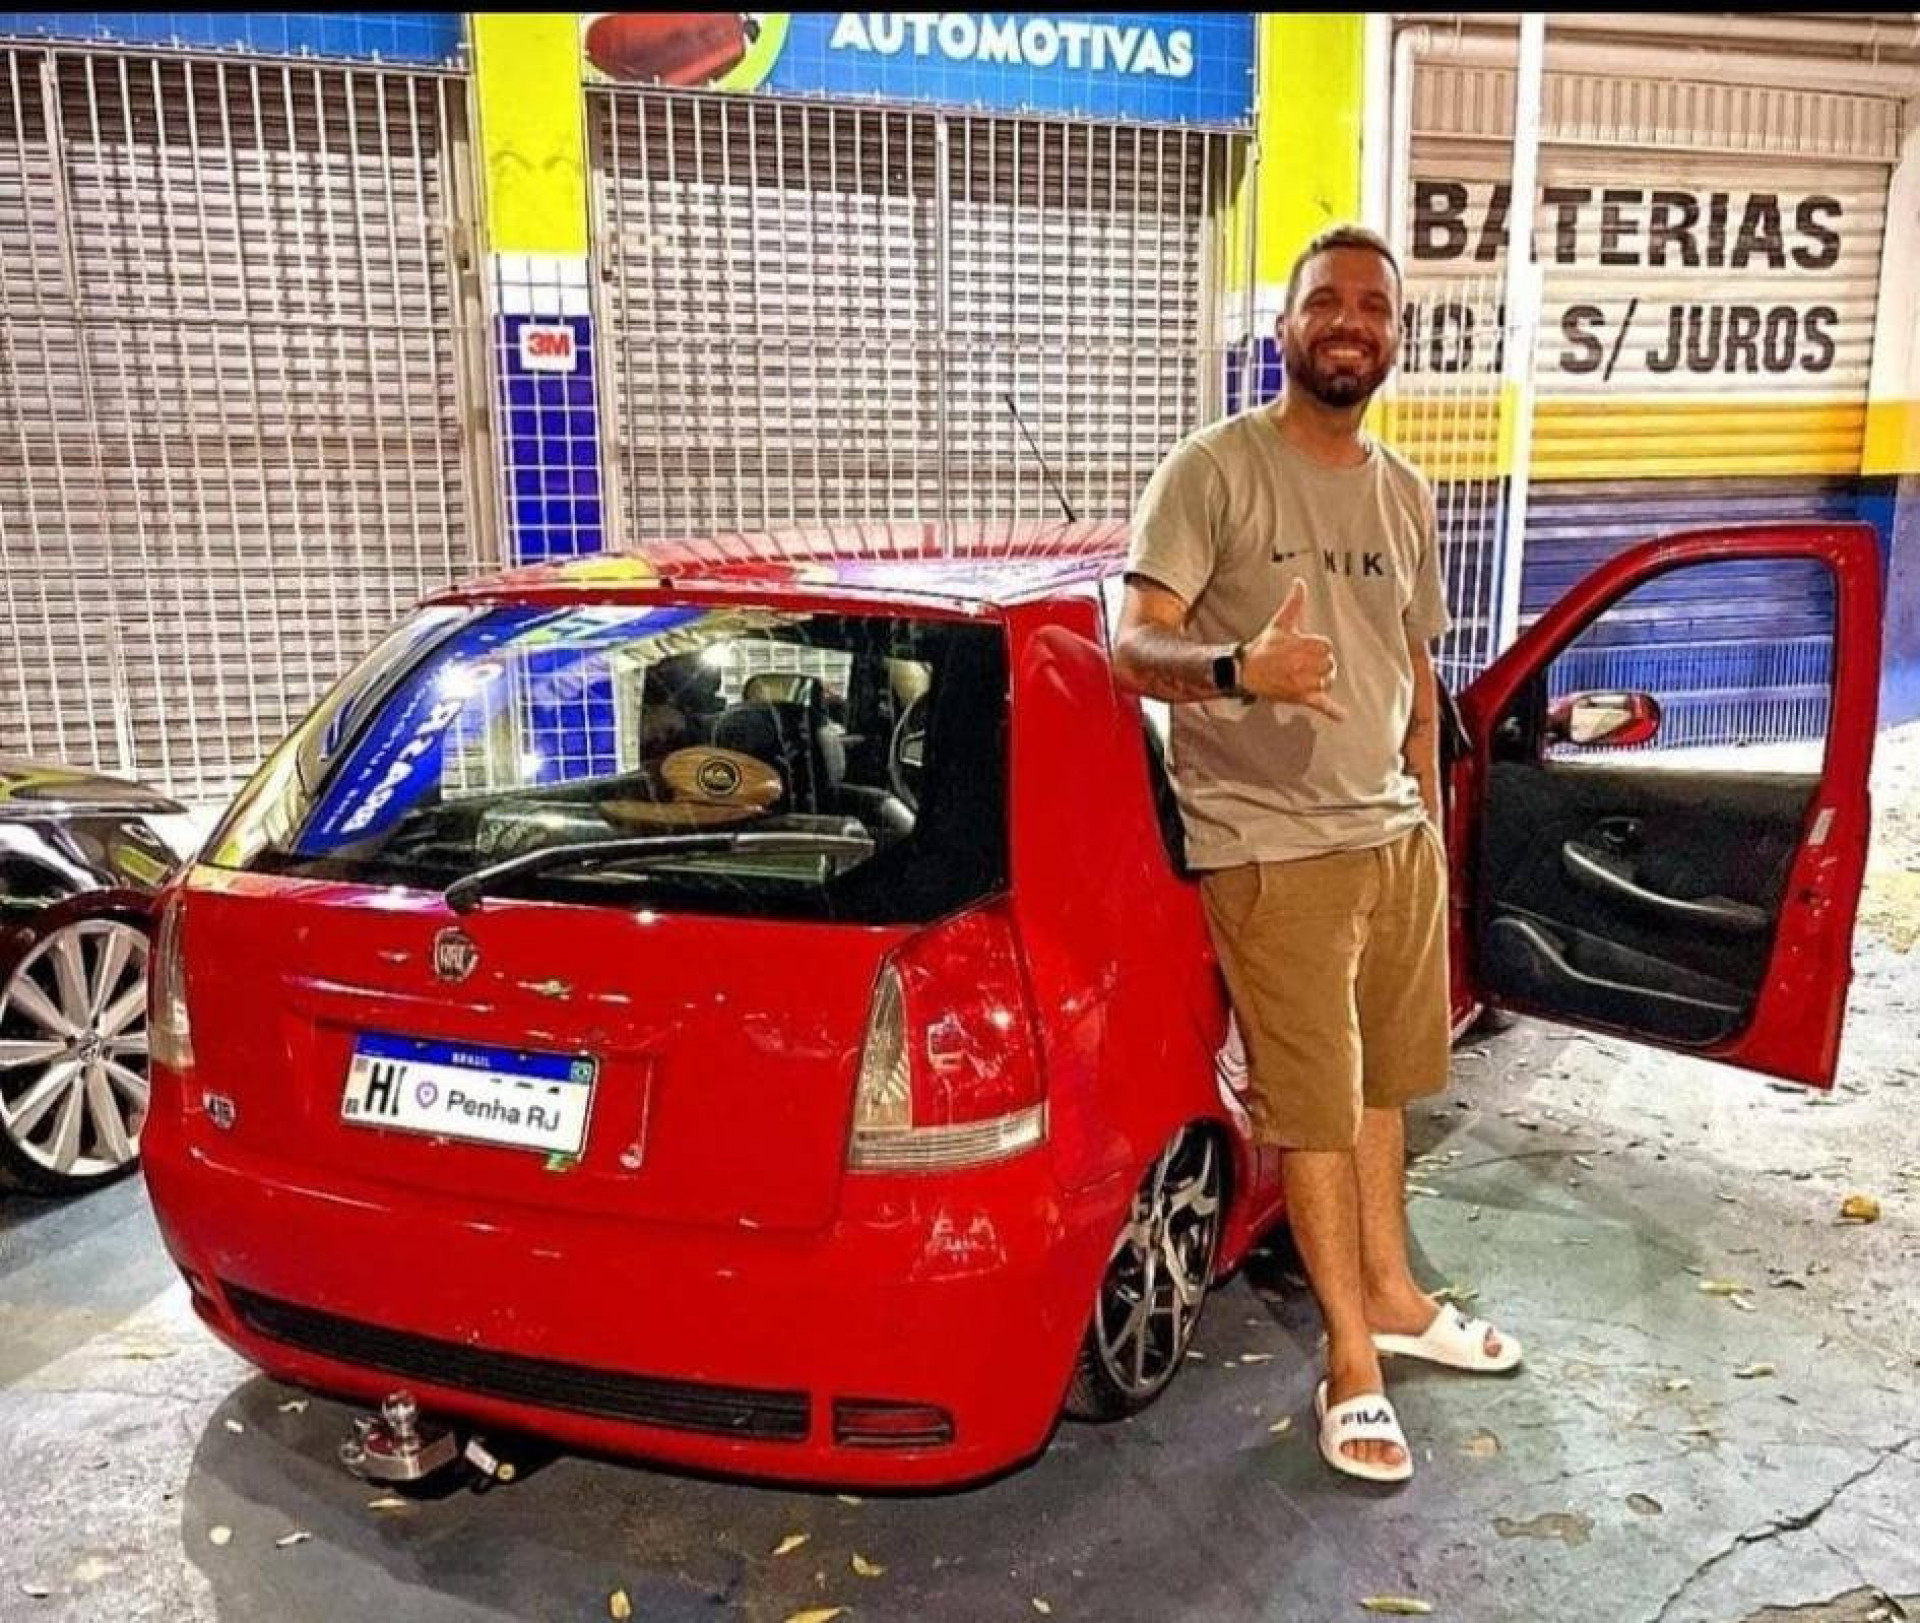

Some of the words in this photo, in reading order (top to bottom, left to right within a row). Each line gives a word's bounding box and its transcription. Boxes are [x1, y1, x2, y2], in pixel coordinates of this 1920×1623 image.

[829, 12, 1194, 78] AUTOMOTIVAS
[1411, 181, 1844, 269] BATERIAS
[527, 331, 571, 357] 3M
[1558, 297, 1639, 382] S/
[1644, 303, 1840, 374] JUROS
[1323, 549, 1385, 577] NIK
[1340, 1407, 1392, 1426] FILA
